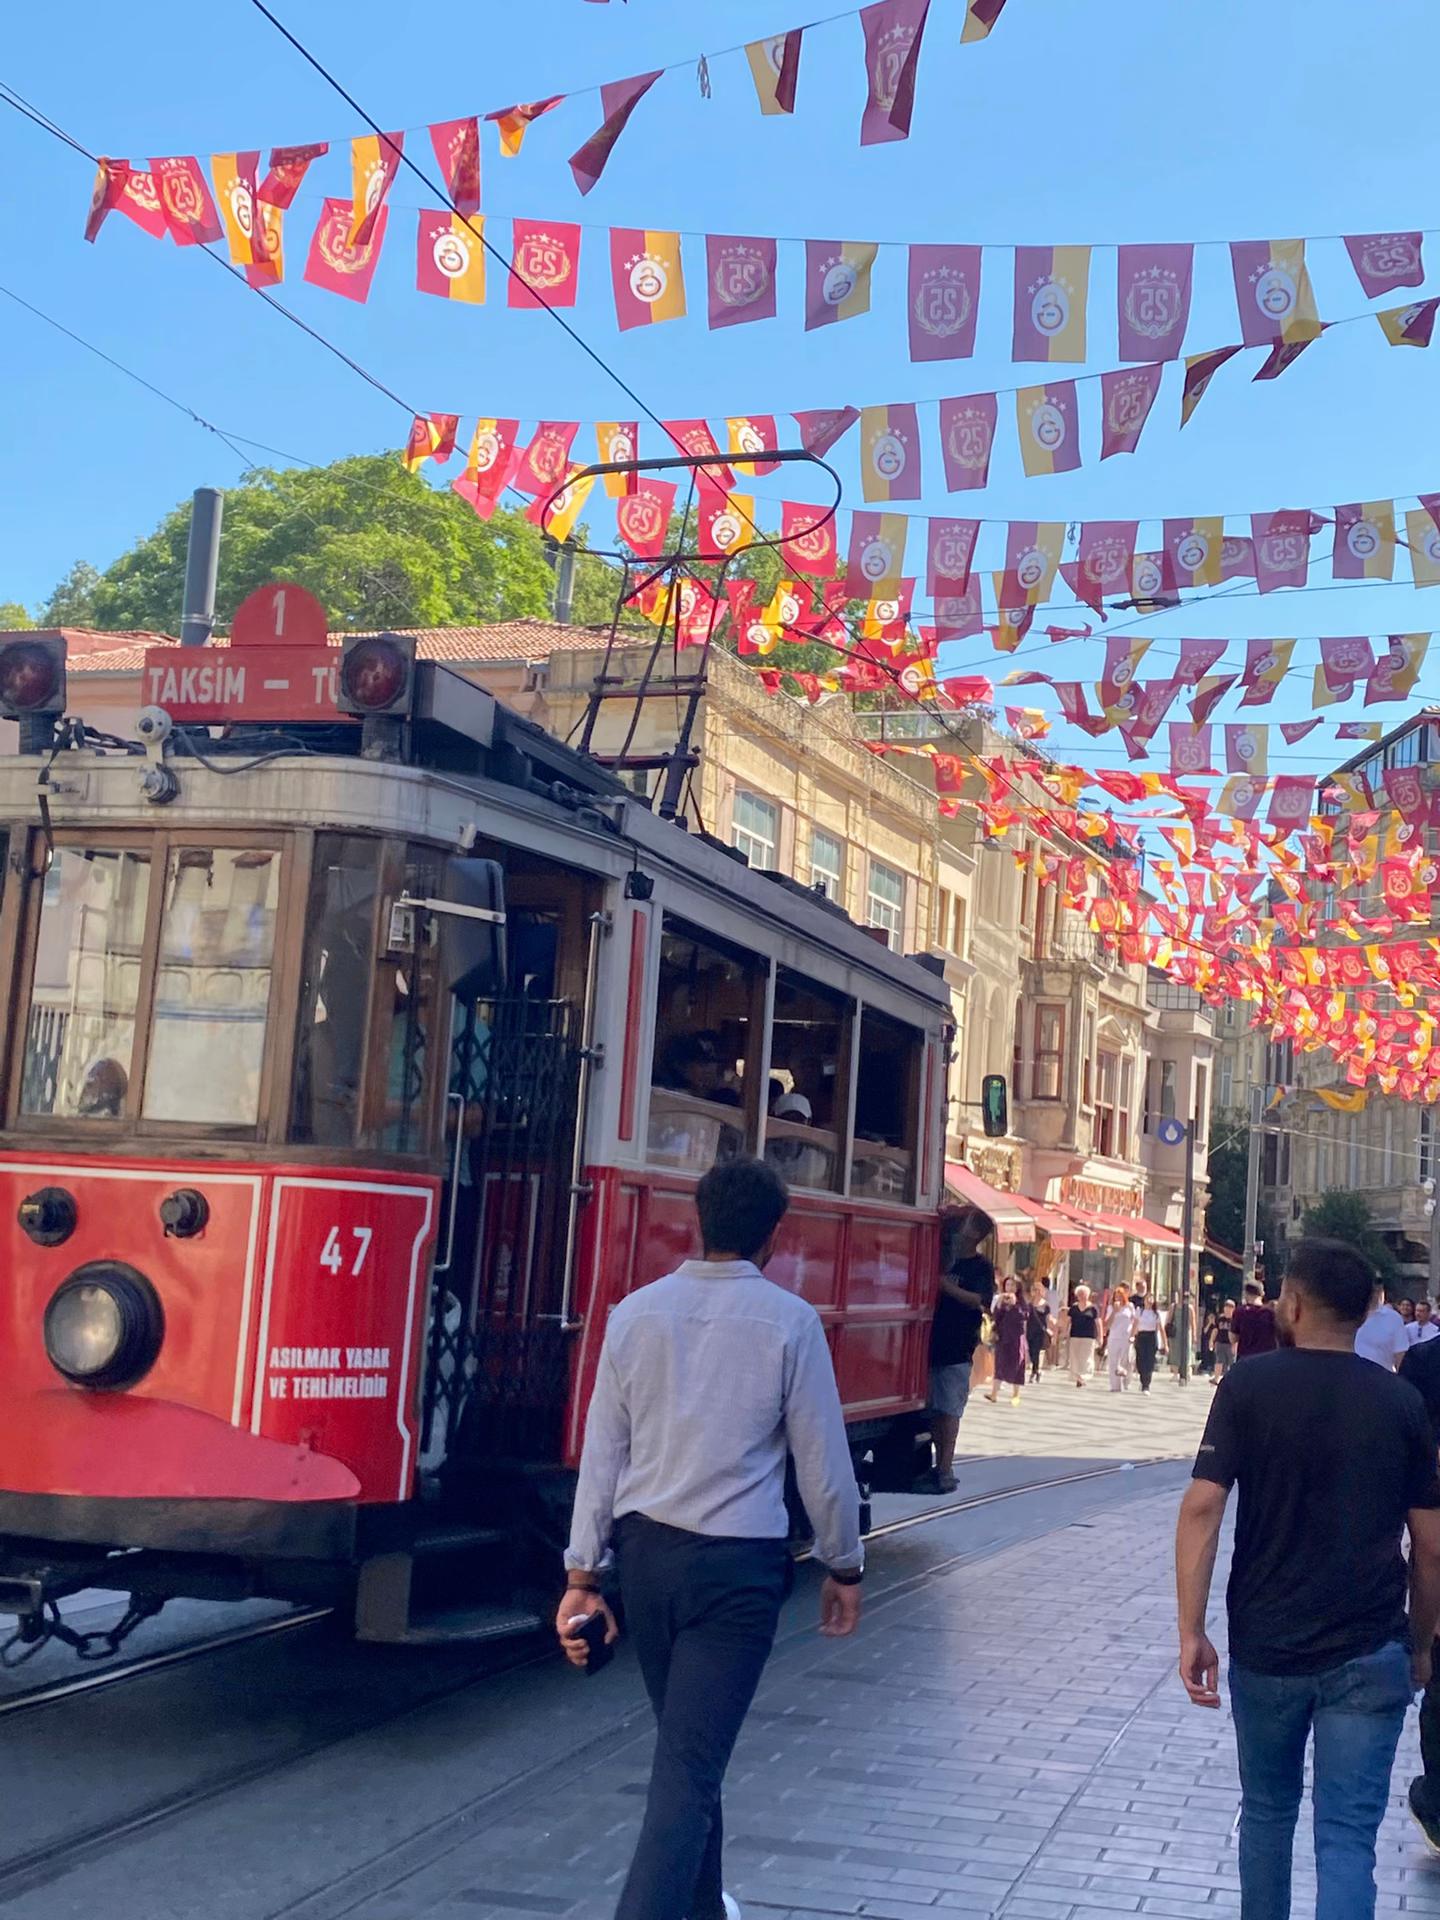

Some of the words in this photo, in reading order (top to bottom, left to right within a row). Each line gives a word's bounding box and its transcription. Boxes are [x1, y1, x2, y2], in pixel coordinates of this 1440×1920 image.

[171, 177, 195, 208] 25
[1120, 391, 1142, 422] 25
[961, 427, 982, 456] 25
[272, 590, 286, 636] 1
[149, 657, 246, 704] TAKSİM
[346, 1347, 390, 1369] YASAK
[269, 1376, 287, 1399] VE
